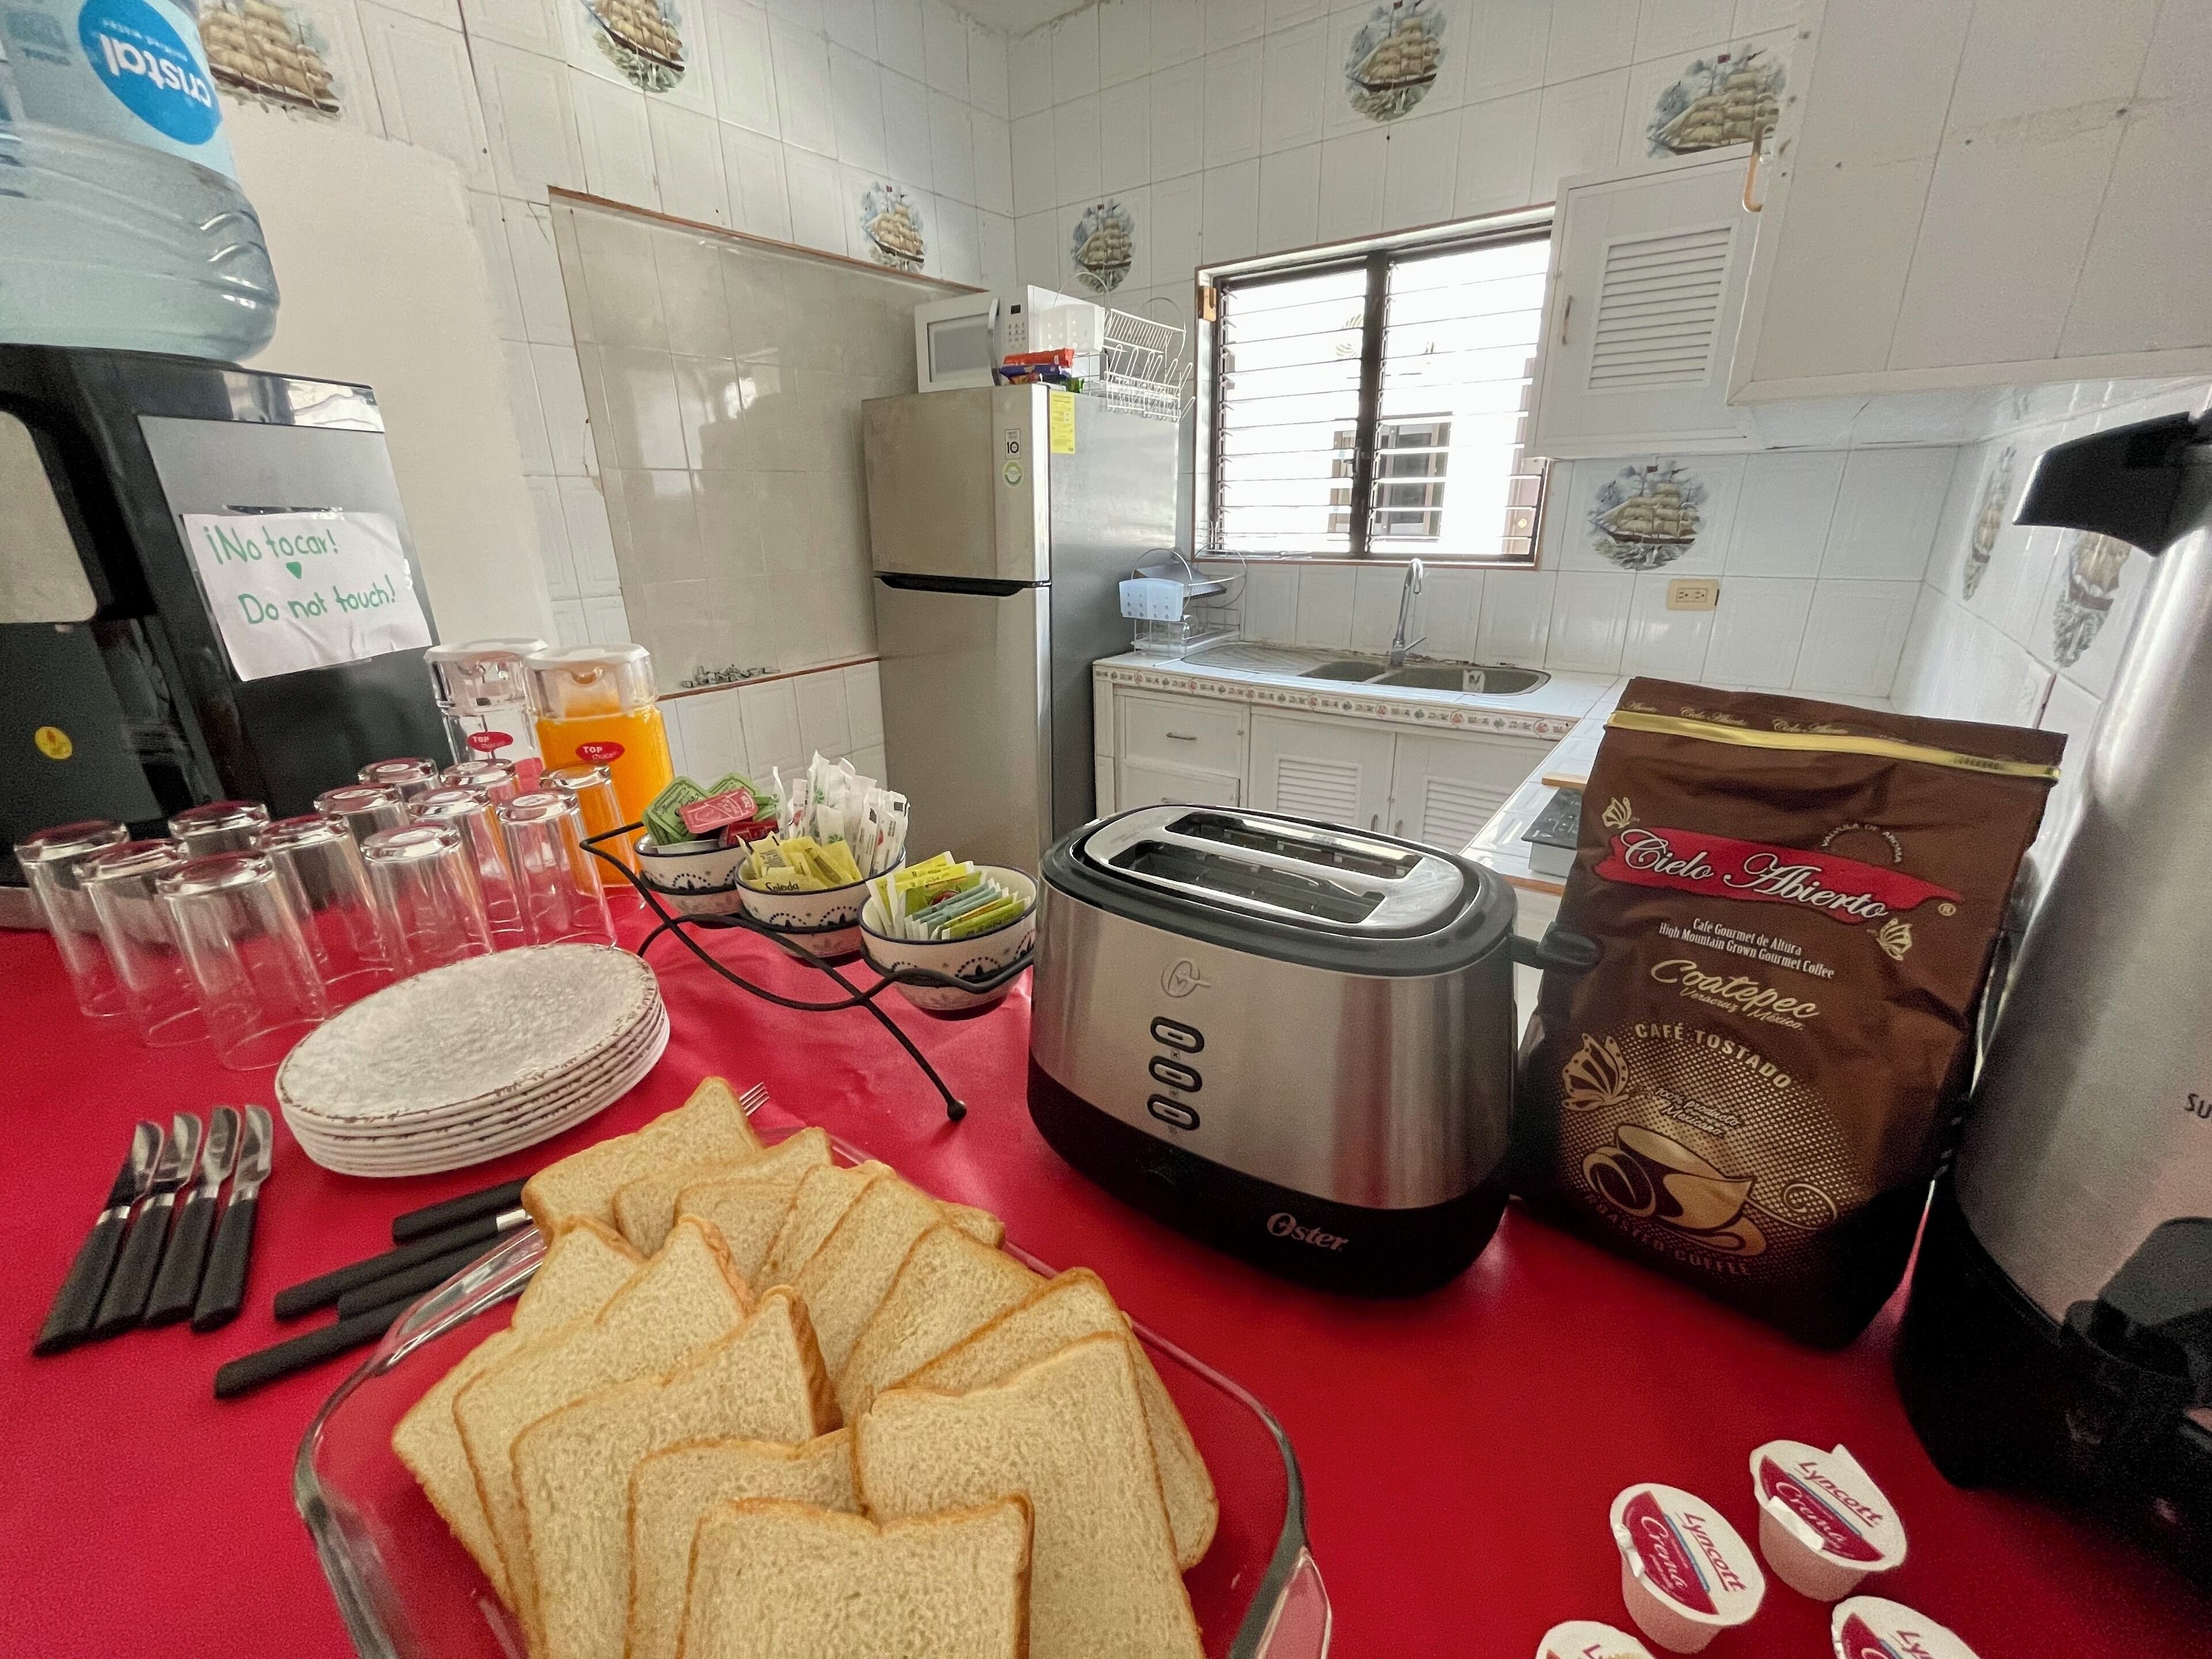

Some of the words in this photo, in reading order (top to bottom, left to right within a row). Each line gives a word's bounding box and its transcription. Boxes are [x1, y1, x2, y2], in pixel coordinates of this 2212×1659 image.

[100, 32, 211, 108] cristal
[262, 525, 339, 558] tocar!
[237, 593, 279, 624] Do
[287, 592, 328, 619] not
[332, 574, 396, 613] touch!
[582, 746, 603, 754] TOP
[1620, 828, 1714, 880] Cielo
[1723, 853, 1889, 918] Abierto
[1658, 922, 1680, 938] High
[1681, 928, 1725, 950] Mountain
[1726, 941, 1758, 959] Grown
[1758, 949, 1802, 970] Gourmet
[1802, 960, 1835, 979] Coffee
[1693, 918, 1714, 933] Café
[1714, 923, 1756, 944] Gourmet
[1757, 934, 1769, 946] de
[1770, 937, 1802, 956] Altura
[1651, 959, 1820, 1018] Coatepec
[1679, 987, 1738, 1013] Veracruz
[1635, 1022, 1684, 1040] CAFÉ
[1695, 1029, 1791, 1088] TOSTADO
[1683, 1100, 1742, 1127] producto
[2183, 1093, 2212, 1119] SU
[1267, 1212, 1350, 1251] Oster
[1797, 1461, 1883, 1526] Lyncott
[1641, 1516, 1688, 1591] Crema
[1681, 1512, 1747, 1592] Lyncott
